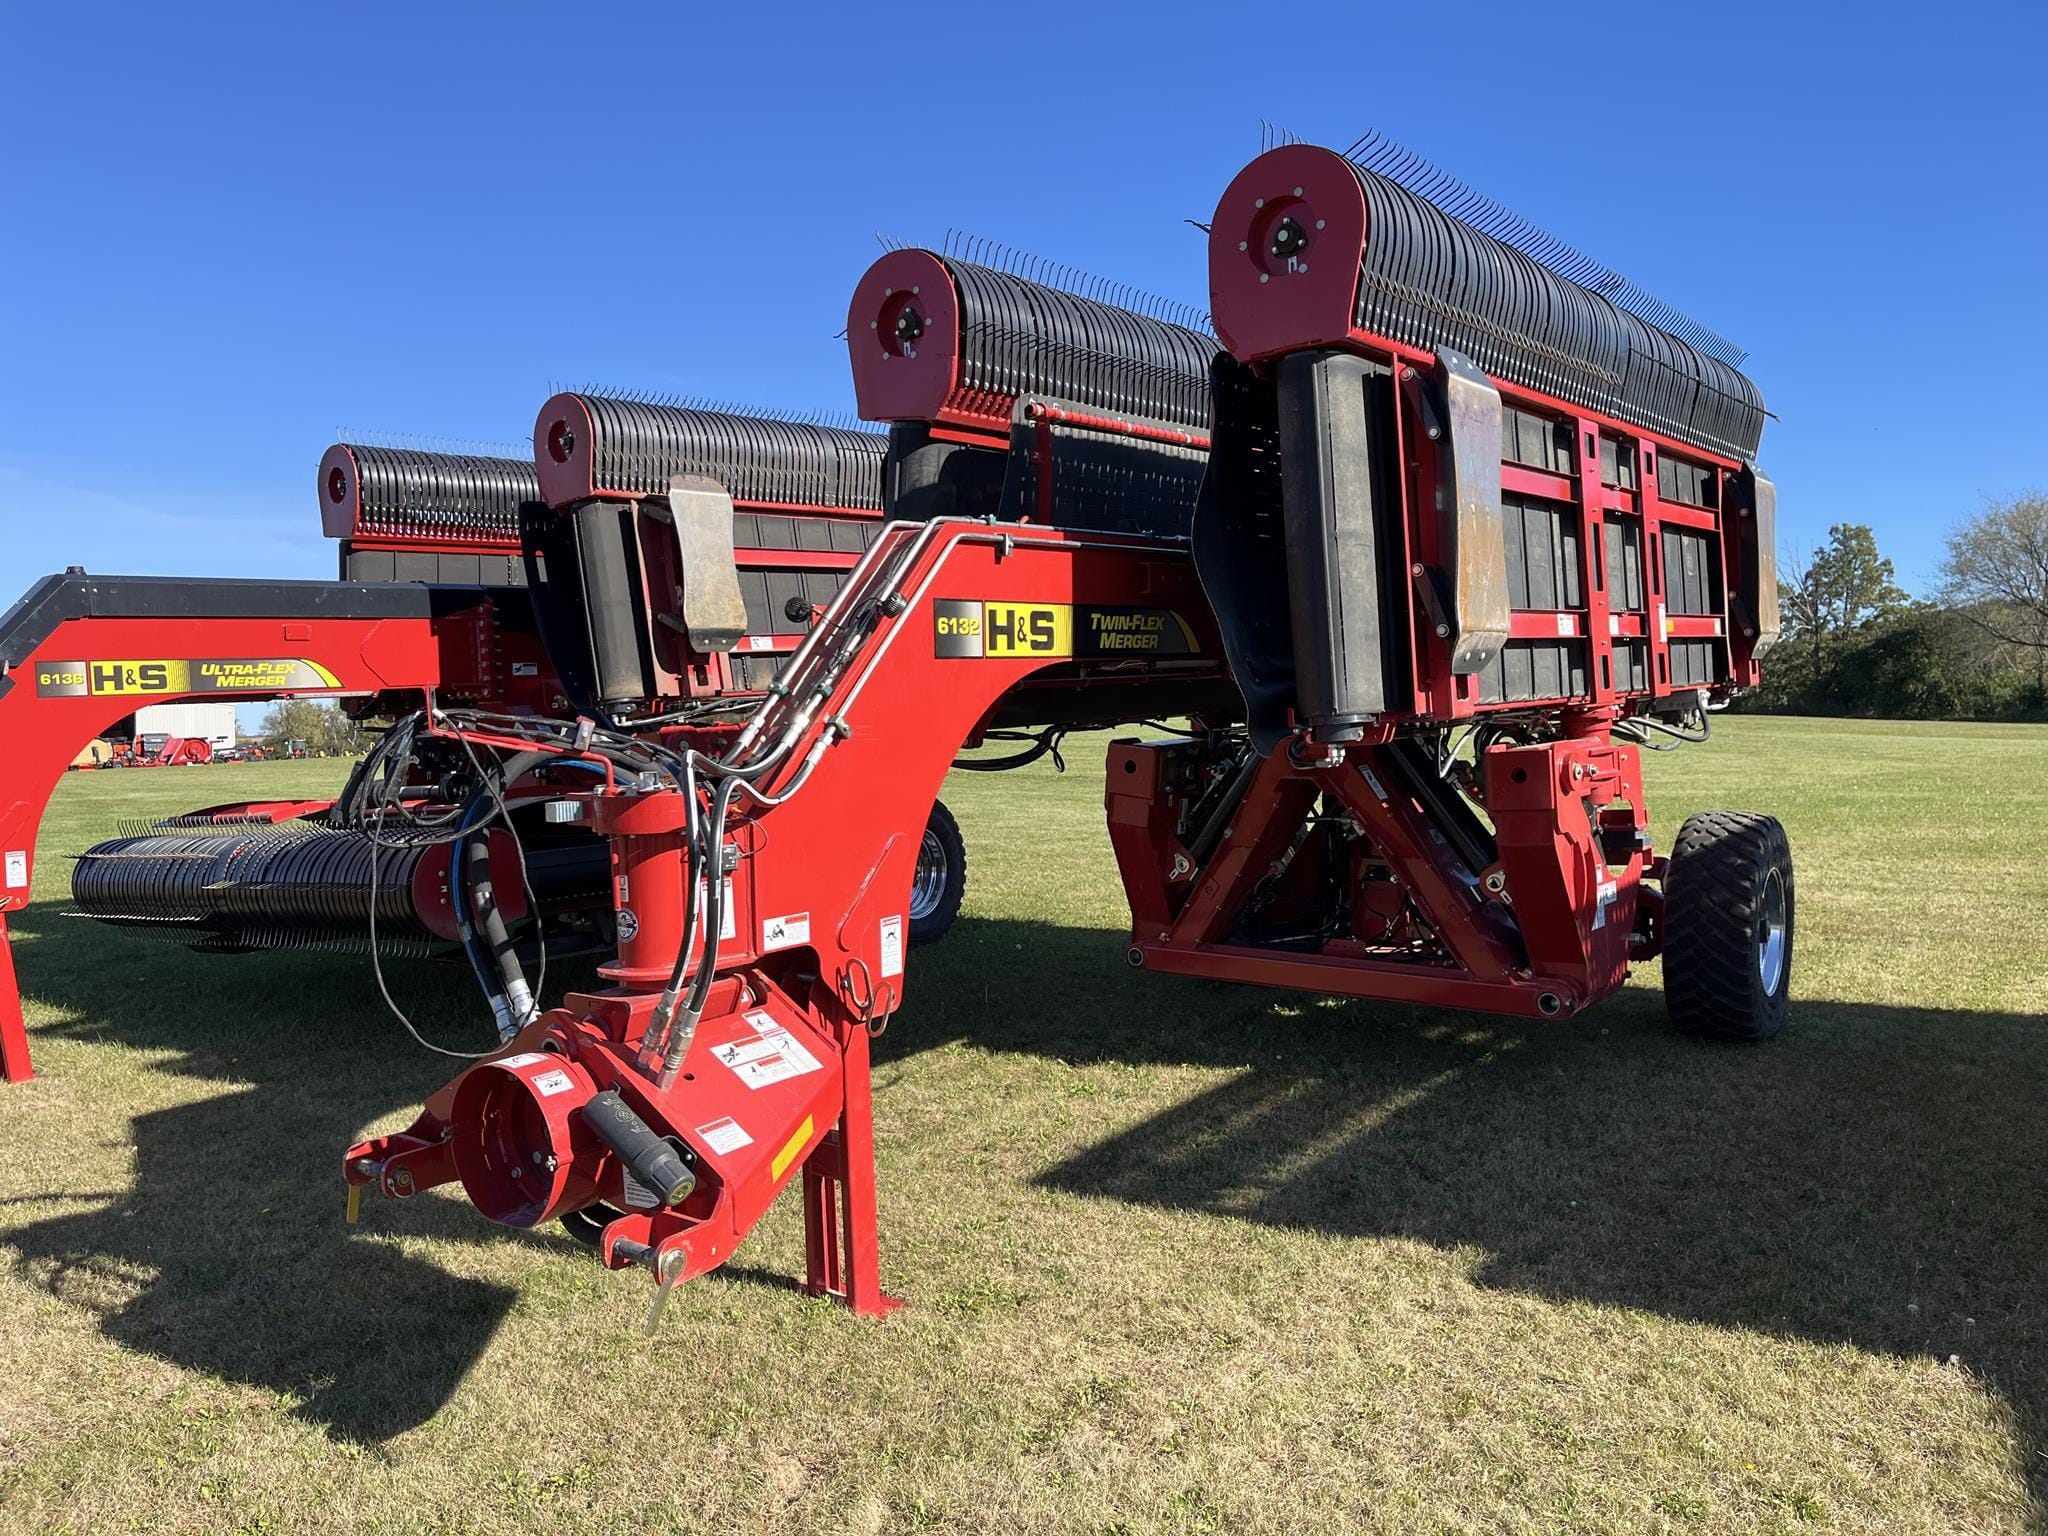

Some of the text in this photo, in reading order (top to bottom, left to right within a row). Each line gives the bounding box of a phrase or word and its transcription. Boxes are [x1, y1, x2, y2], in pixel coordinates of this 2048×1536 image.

[938, 609, 1055, 651] 6132 H&S
[1091, 613, 1165, 631] TWIN-FLEX
[1100, 632, 1159, 649] MERGER
[40, 664, 168, 691] 6136 H&S
[201, 662, 295, 677] ULTRA-FLEX
[216, 675, 287, 688] MERGER
